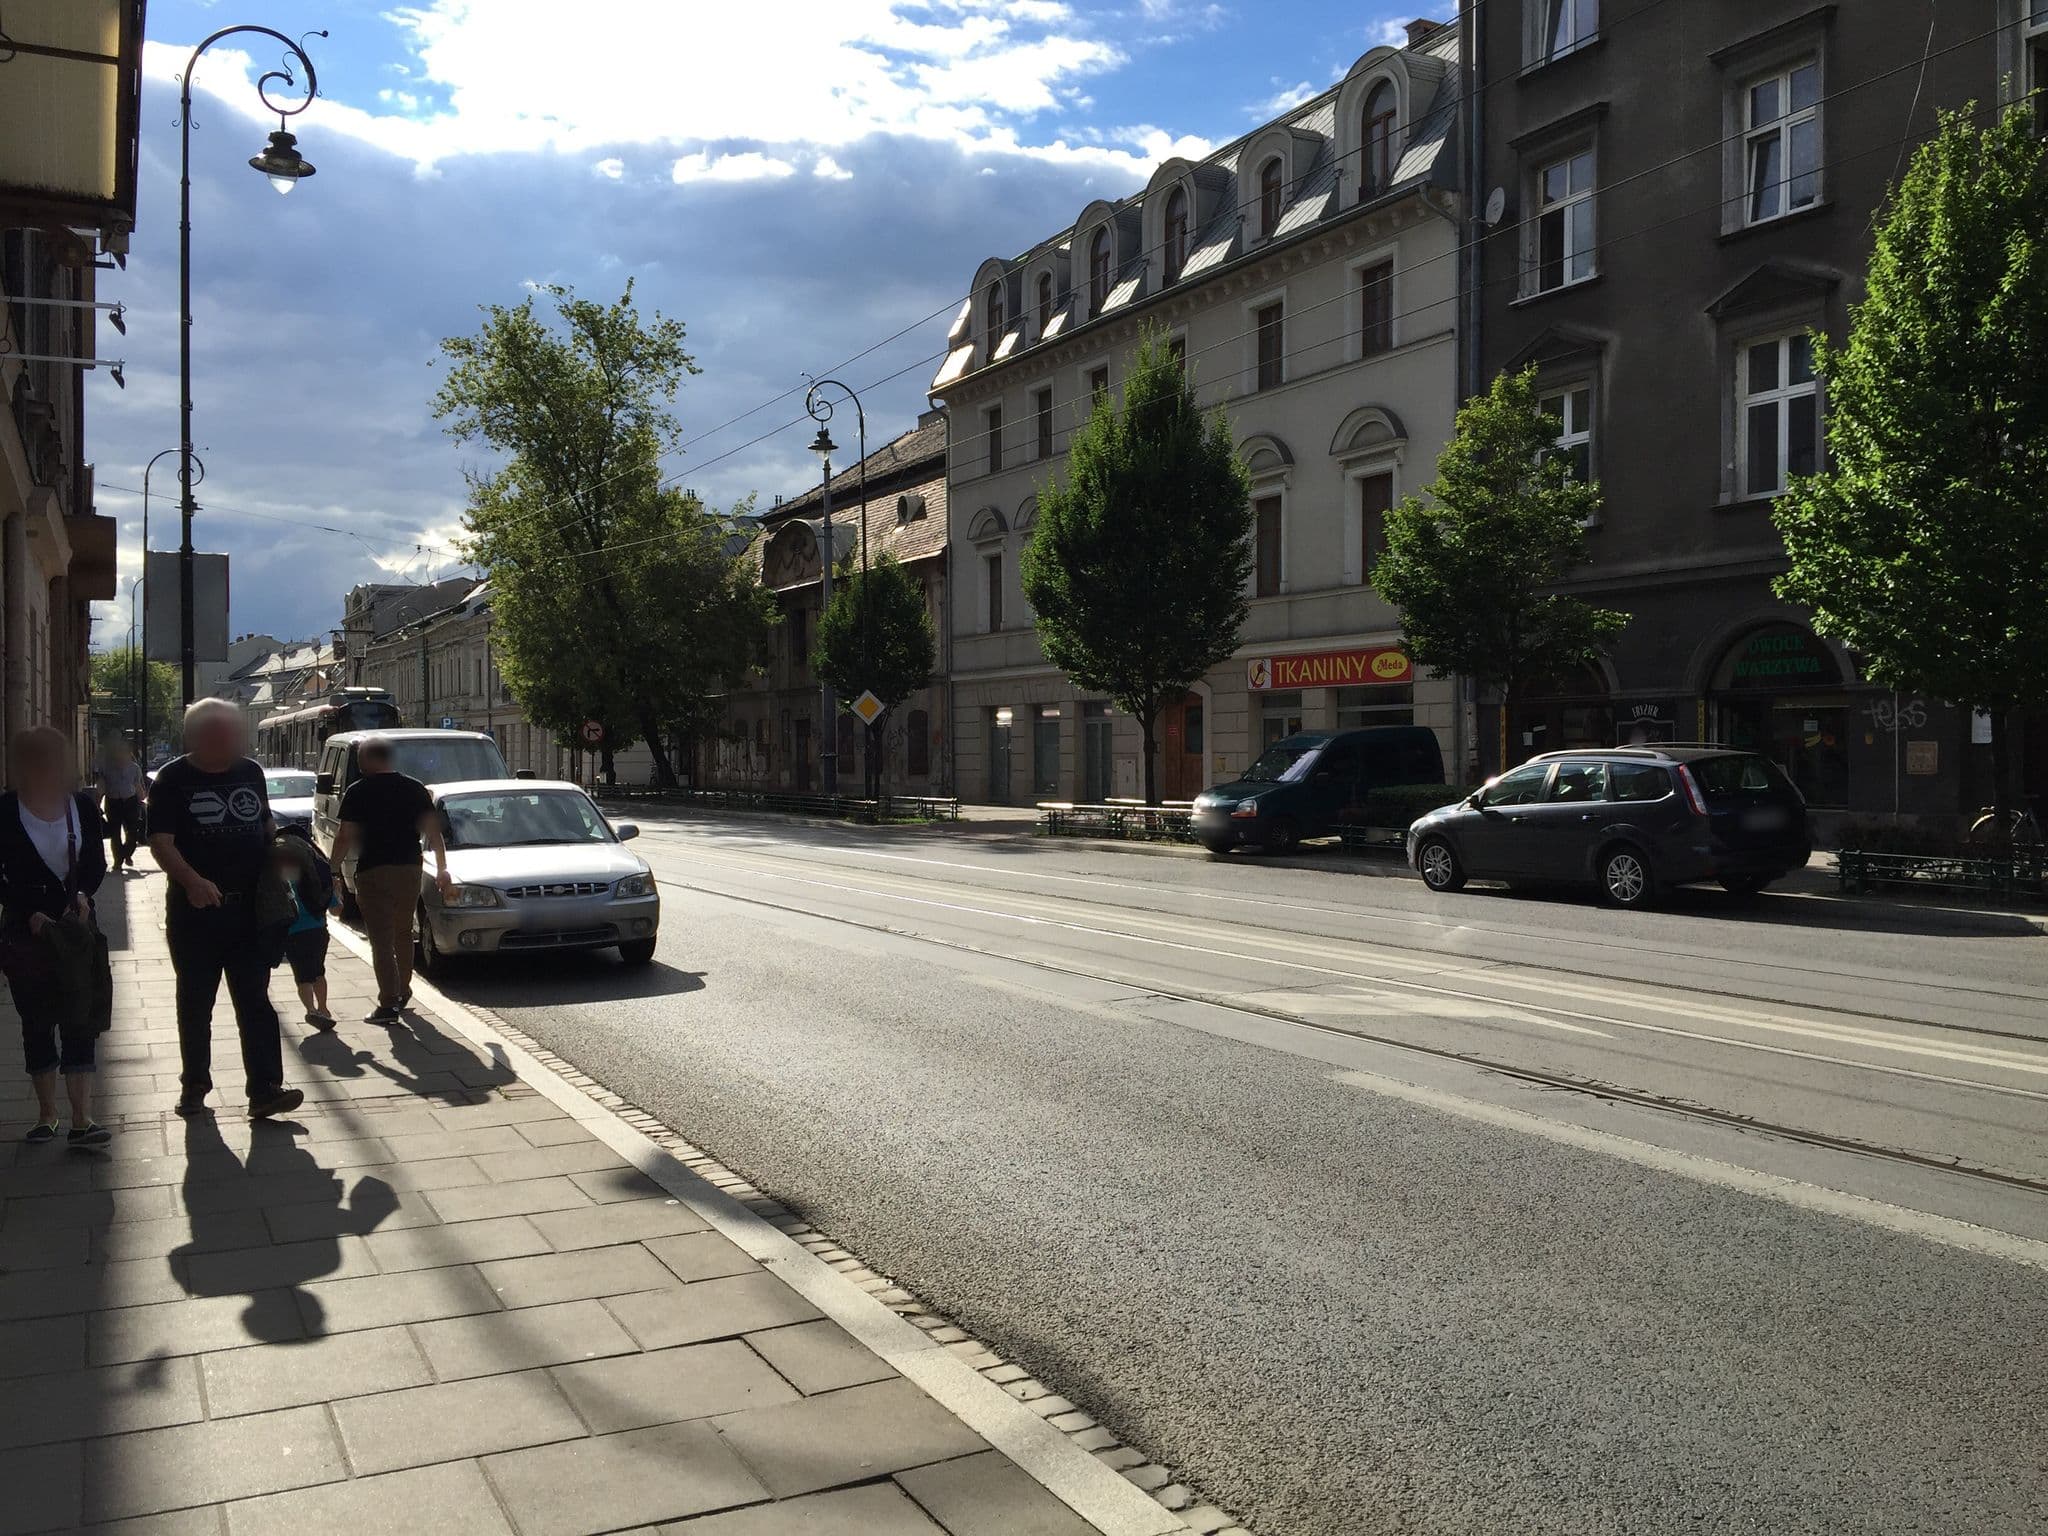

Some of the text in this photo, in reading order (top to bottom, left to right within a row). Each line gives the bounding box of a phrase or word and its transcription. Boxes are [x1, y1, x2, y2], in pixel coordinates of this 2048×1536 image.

[1276, 655, 1403, 684] TKANINY Meda
[1733, 657, 1820, 677] WARZYWA
[443, 718, 451, 728] P
